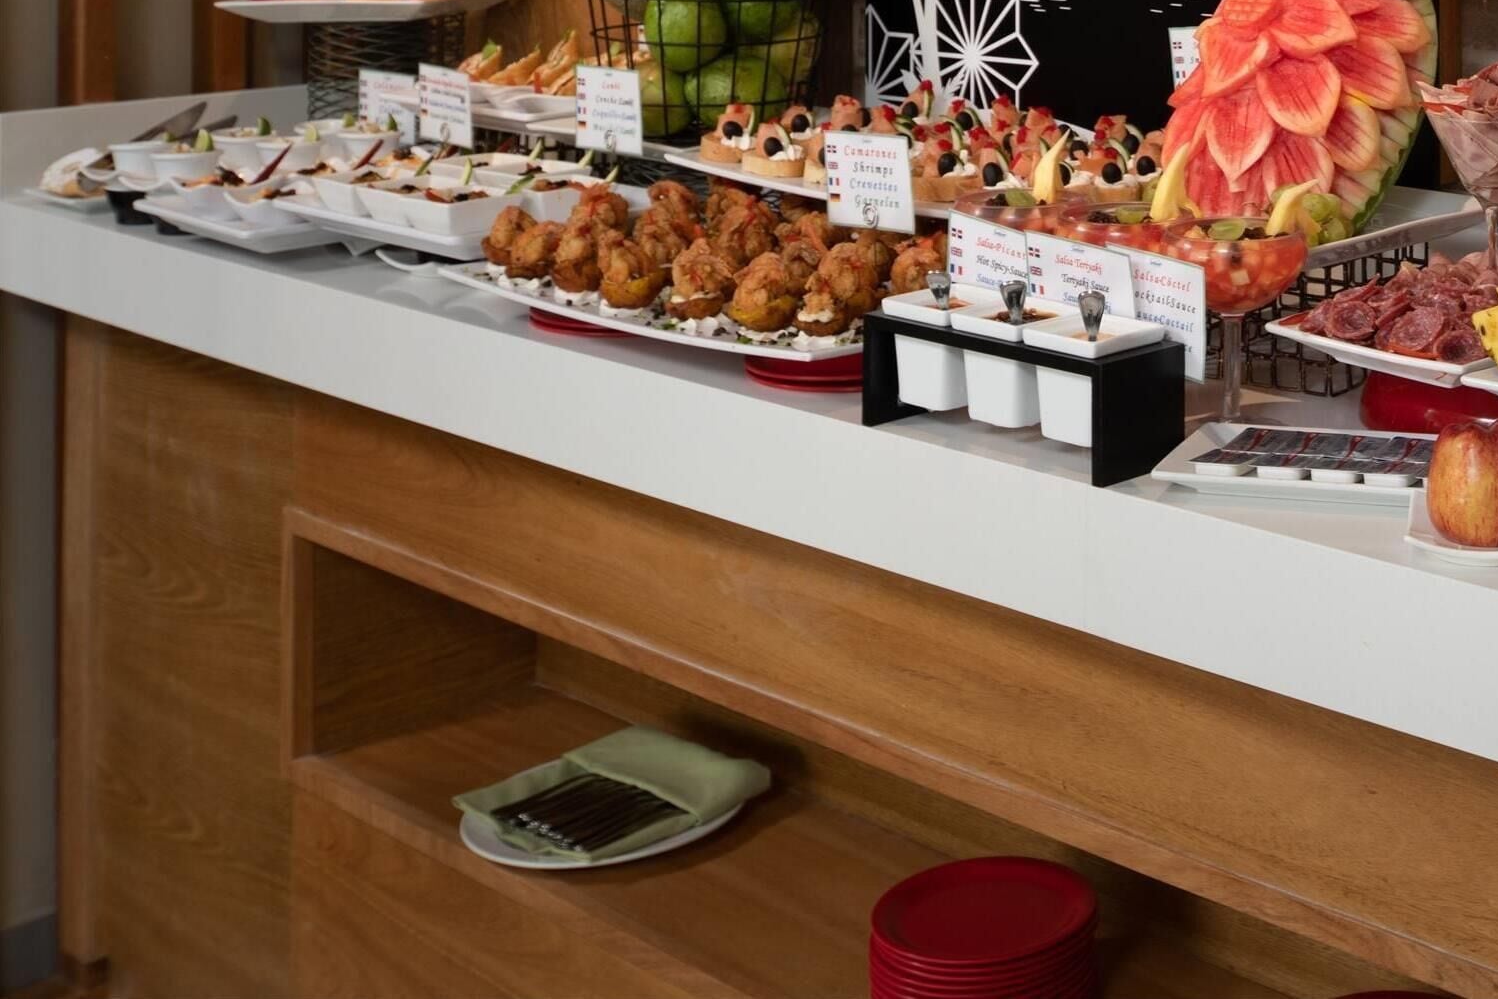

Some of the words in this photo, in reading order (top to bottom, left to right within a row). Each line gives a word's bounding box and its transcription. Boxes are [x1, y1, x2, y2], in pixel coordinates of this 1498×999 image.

[843, 144, 897, 160] Camarones
[852, 161, 893, 178] Shrimps
[849, 177, 898, 192] Crevettes
[1134, 290, 1169, 304] ocktail
